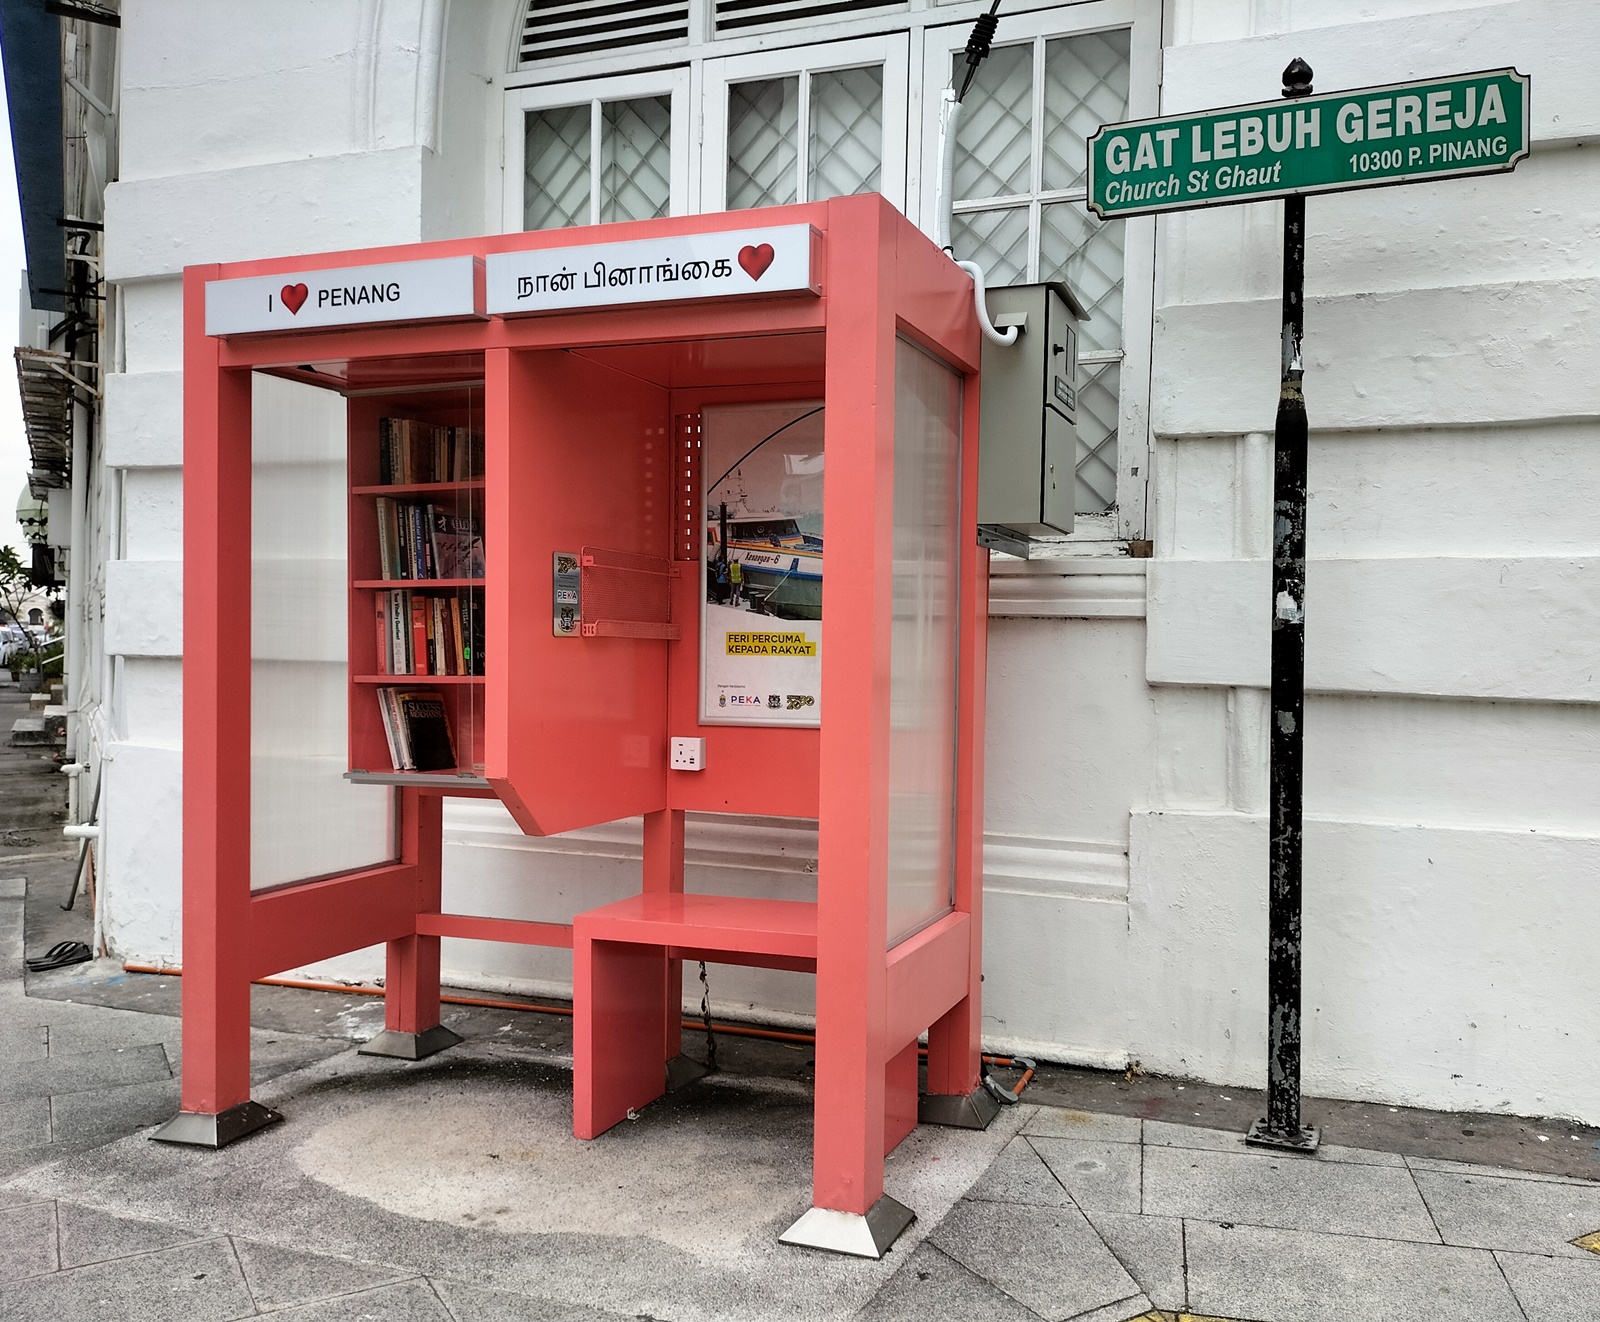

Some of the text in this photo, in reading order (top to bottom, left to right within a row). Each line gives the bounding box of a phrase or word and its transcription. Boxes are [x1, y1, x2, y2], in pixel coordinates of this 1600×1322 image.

[1105, 84, 1507, 175] GAT LEBUH GEREJA
[1349, 135, 1508, 174] 10300 P. PINANG
[1105, 160, 1282, 205] Church St Ghaut
[516, 256, 732, 301] நான் பினாங்கை
[268, 282, 401, 313] I PENANG
[557, 590, 578, 600] PEKA
[728, 634, 802, 644] FERI PERCUMA
[728, 645, 812, 655] KEPADA RAKYAT
[408, 701, 442, 712] SUCCESS
[730, 695, 761, 704] PEKA
